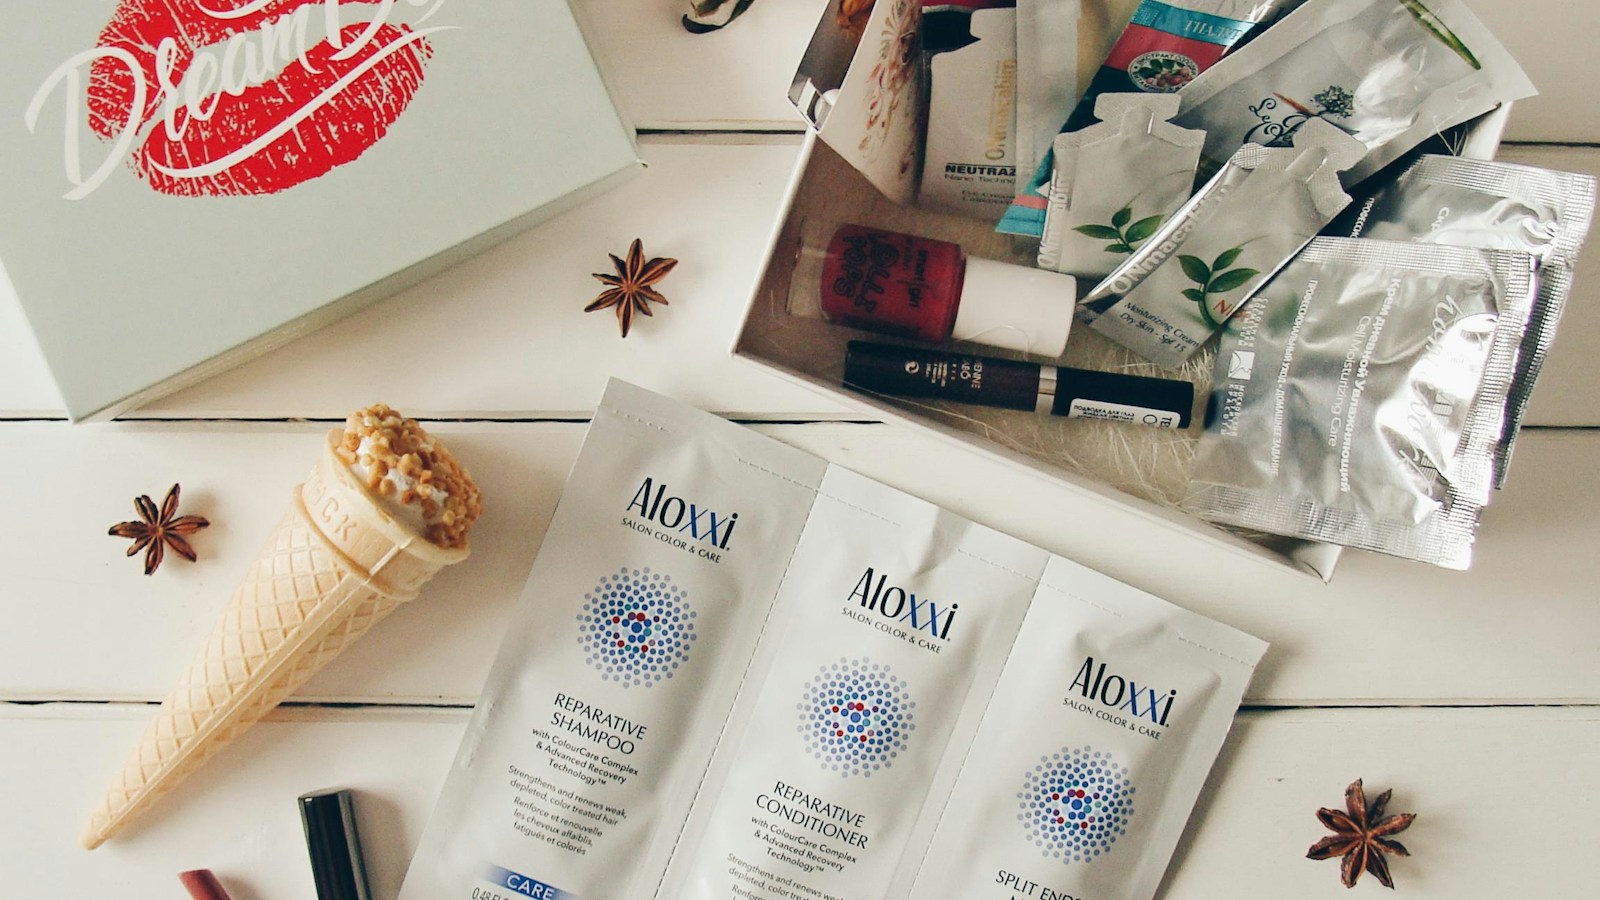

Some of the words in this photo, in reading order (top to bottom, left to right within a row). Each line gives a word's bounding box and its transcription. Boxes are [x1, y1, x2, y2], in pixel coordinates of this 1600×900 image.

[25, 4, 323, 200] Dream
[1379, 278, 1401, 316] Крем
[1120, 312, 1136, 325] Dry
[1136, 320, 1154, 334] Skin
[1174, 343, 1186, 353] 15
[1124, 302, 1173, 332] Moisturizing
[1173, 328, 1200, 348] Cream
[1283, 279, 1318, 362] ПРОФЕССИОНАЛЬНЫЙ
[1352, 315, 1371, 337] Cell
[1356, 315, 1386, 379] дневной
[1277, 361, 1291, 384] УХОД
[1330, 338, 1362, 415] Moisturizing
[1328, 416, 1342, 448] Care
[1339, 379, 1366, 493] Увлажняющий
[626, 477, 739, 551] Aloxxi
[621, 516, 652, 536] SALON
[654, 532, 687, 552] COLOR
[688, 545, 696, 554] &
[698, 547, 722, 564] CARE
[848, 567, 959, 642] Aloxxi
[841, 606, 871, 625] SALON
[873, 620, 907, 642] COLOR
[909, 635, 916, 644] &
[918, 638, 942, 654] CARE
[1068, 656, 1177, 728] Aloxxi
[550, 711, 636, 755] SHAMPOO
[554, 692, 648, 741] REPARATIVE
[1063, 697, 1093, 716] SALON
[1095, 709, 1127, 728] COLOR
[1129, 722, 1136, 731] &
[1138, 725, 1161, 740] CARE
[532, 728, 550, 741] with
[551, 735, 599, 762] ColourCare
[601, 756, 639, 776] Complex
[535, 741, 543, 750] &
[544, 744, 587, 769] Advanced
[588, 762, 627, 785] Recovery
[508, 765, 557, 793] Strengthens
[557, 786, 574, 800] and
[574, 794, 604, 811] renews
[604, 804, 628, 819] weak,
[509, 778, 548, 801] depleted,
[549, 797, 571, 811] color
[572, 804, 599, 821] treated
[599, 812, 619, 826] hair
[774, 781, 866, 828] REPARATIVE
[513, 797, 549, 817] Renforce
[550, 811, 560, 822] et
[560, 817, 603, 837] renouvelle
[513, 809, 525, 822] les
[526, 814, 560, 835] cheveux
[561, 827, 593, 847] affaiblis,
[513, 822, 545, 841] fatigués
[546, 835, 555, 845] et
[556, 838, 586, 856] colorés
[751, 816, 769, 828] with
[770, 823, 818, 849] ColourCare
[819, 843, 857, 864] Complex
[756, 794, 868, 849] CONDITIONER
[754, 830, 761, 838] &
[762, 832, 806, 857] Advanced
[806, 850, 845, 872] Recovery
[506, 874, 555, 900] CARE
[727, 853, 774, 880] Strengthens
[775, 875, 792, 886] and
[792, 881, 821, 897] renews
[729, 867, 765, 890] depleted,
[768, 885, 789, 897] color
[995, 870, 1038, 896] SPLIT
[1040, 887, 1082, 900] END
